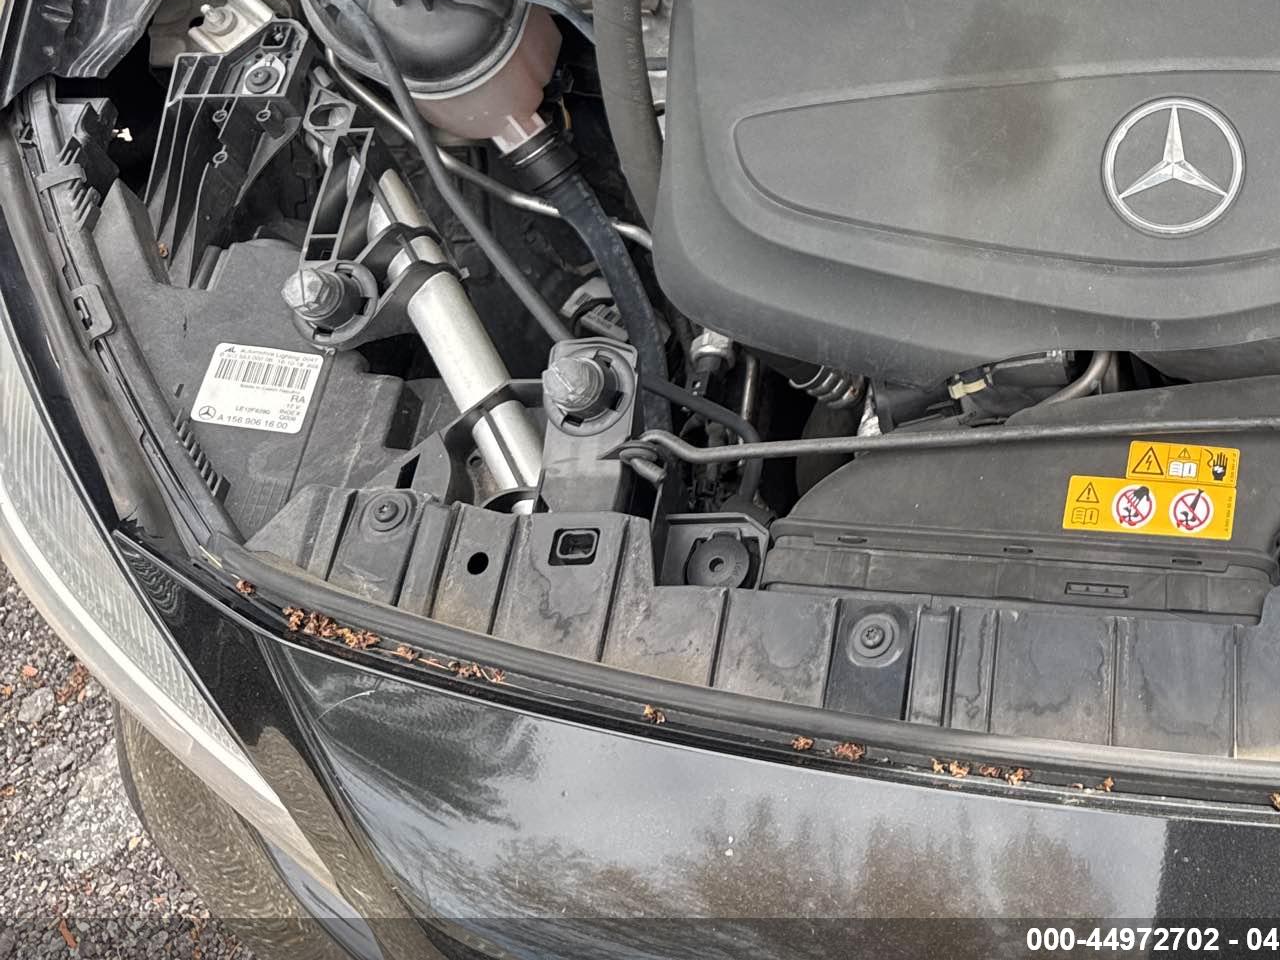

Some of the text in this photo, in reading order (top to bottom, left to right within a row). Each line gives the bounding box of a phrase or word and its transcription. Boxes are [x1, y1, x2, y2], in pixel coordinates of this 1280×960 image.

[290, 394, 305, 403] RA
[227, 416, 243, 424] 156
[245, 417, 261, 425] 906
